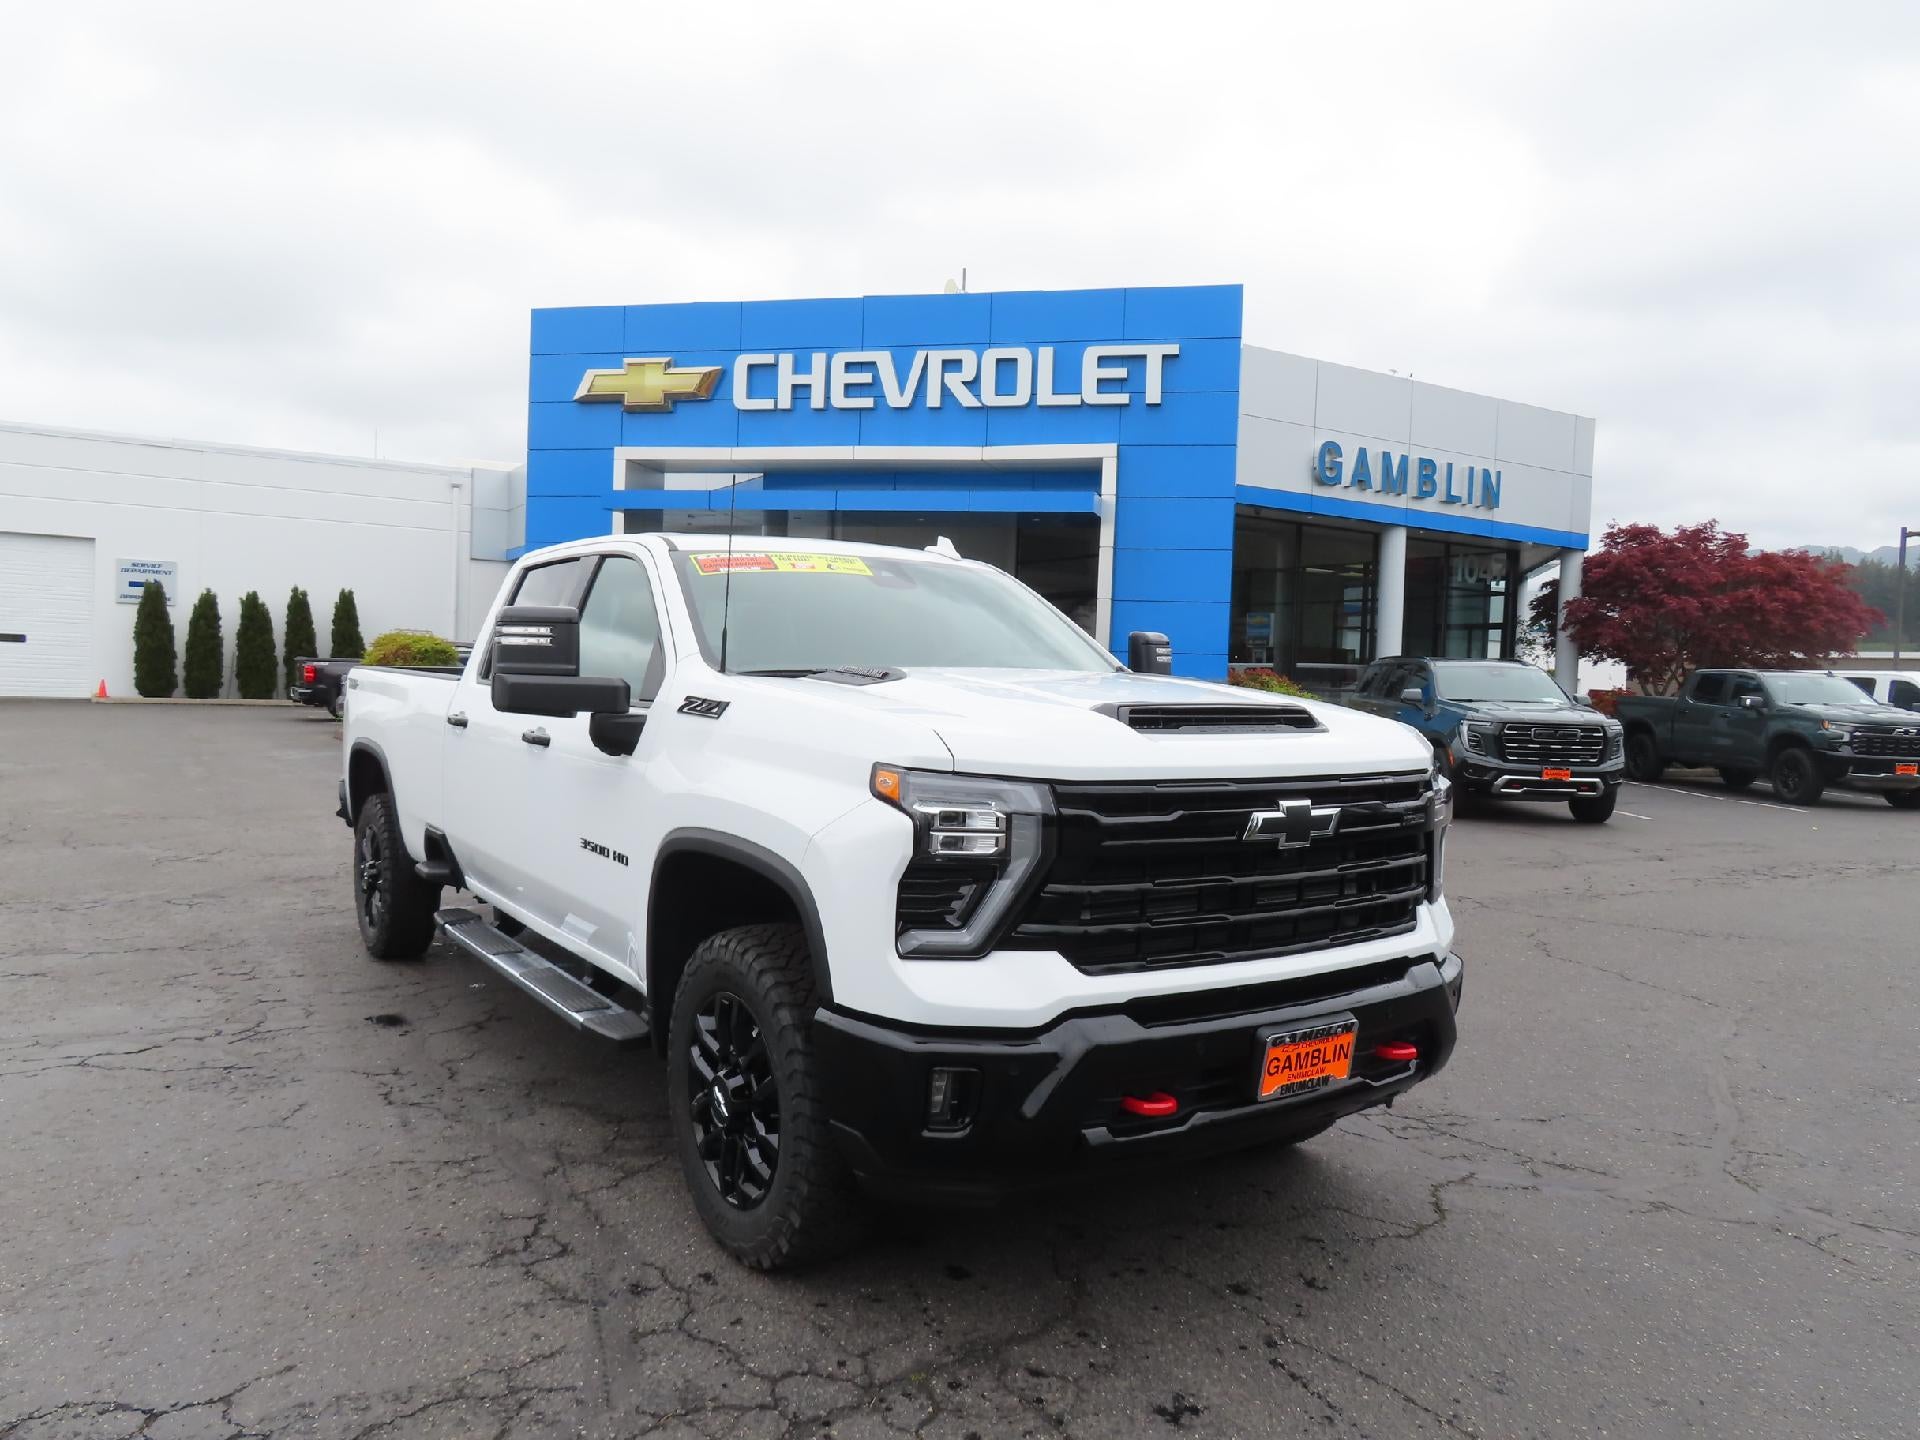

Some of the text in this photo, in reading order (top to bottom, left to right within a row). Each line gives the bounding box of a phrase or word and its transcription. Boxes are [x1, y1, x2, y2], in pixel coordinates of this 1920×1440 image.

[732, 343, 1180, 412] CHEVROLET
[1317, 440, 1502, 509] GAMBLIN
[579, 837, 629, 867] 3500 HD
[1267, 1042, 1350, 1077] GAMBLIN
[1287, 1067, 1326, 1081] ENUMCLAW
[1280, 1074, 1330, 1096] ENUMCLAW
